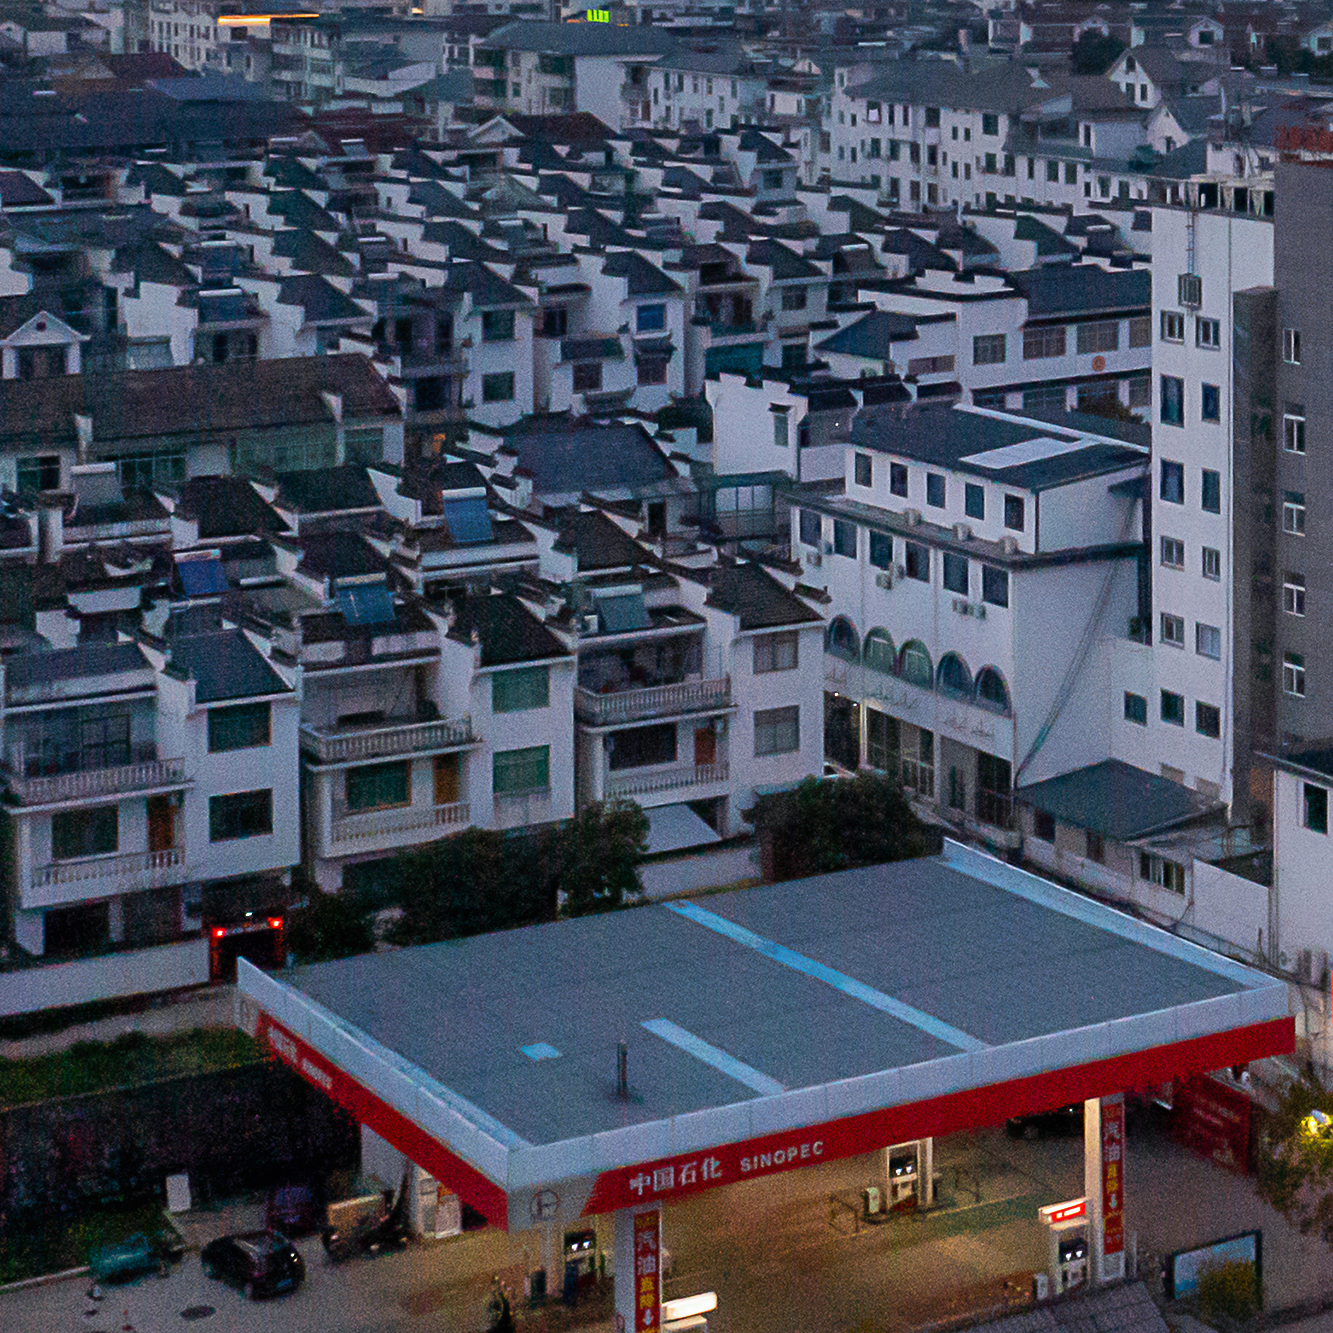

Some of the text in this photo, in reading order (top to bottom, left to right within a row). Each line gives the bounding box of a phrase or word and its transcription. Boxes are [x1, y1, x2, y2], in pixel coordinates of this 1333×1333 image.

[628, 1140, 825, 1196] 中国石化 SINOPEC
